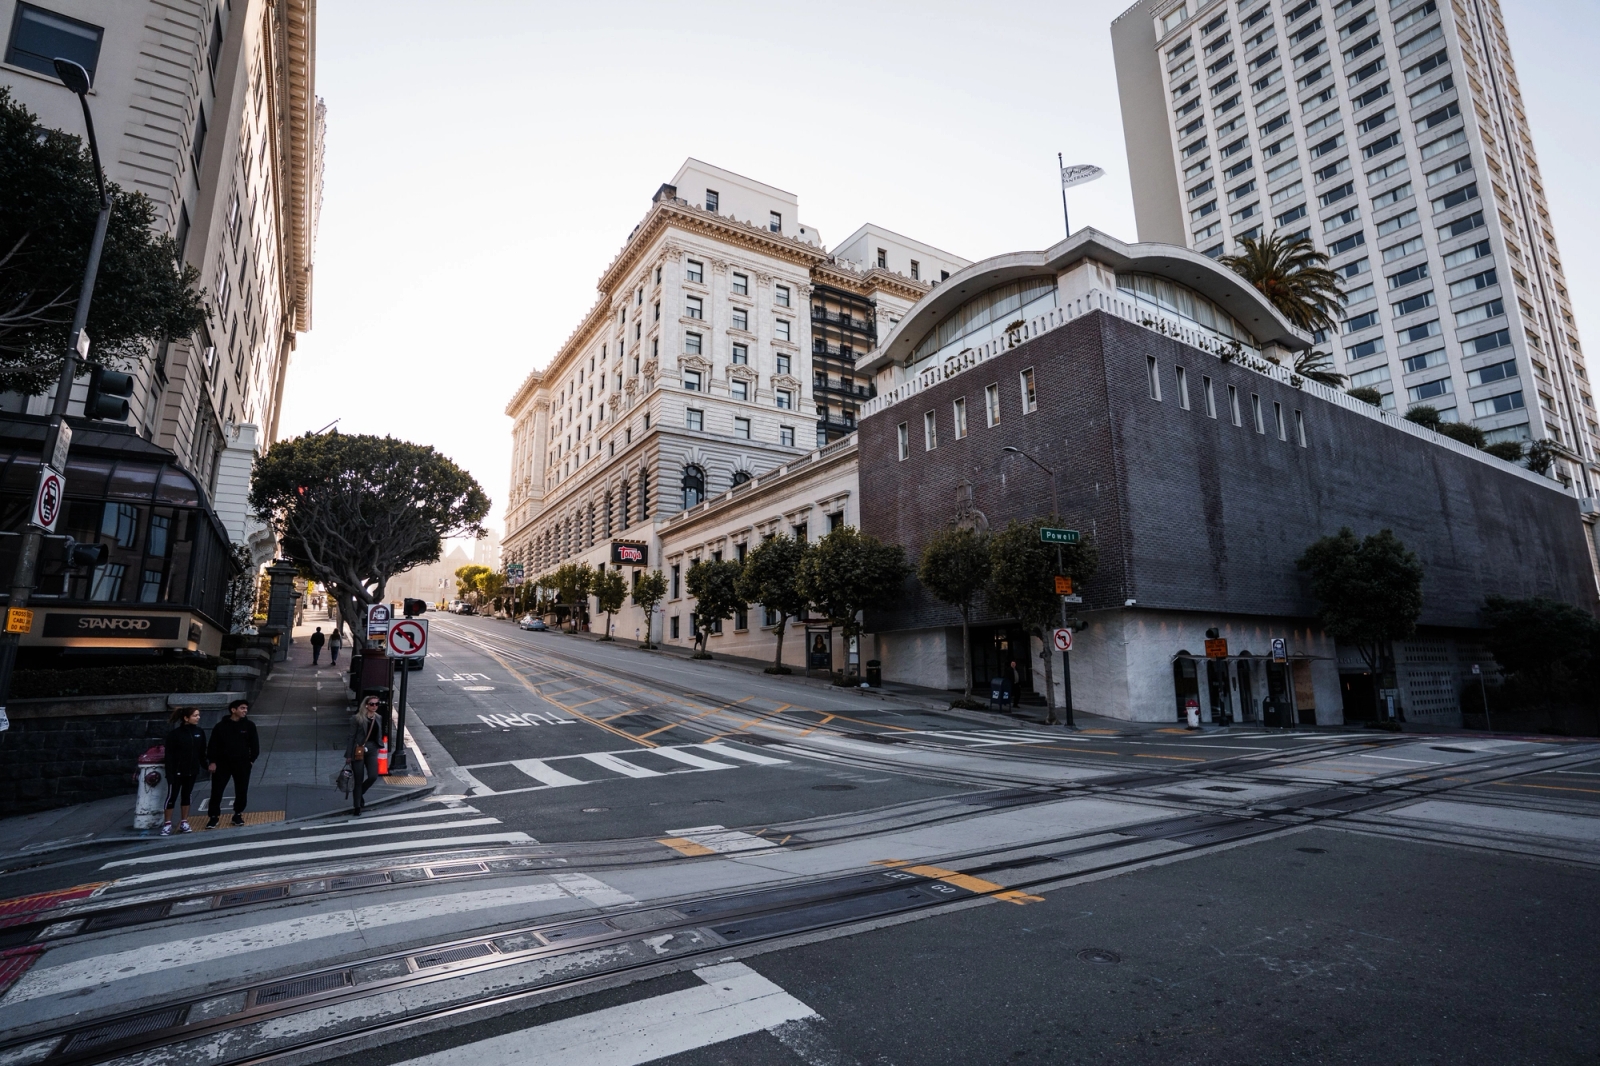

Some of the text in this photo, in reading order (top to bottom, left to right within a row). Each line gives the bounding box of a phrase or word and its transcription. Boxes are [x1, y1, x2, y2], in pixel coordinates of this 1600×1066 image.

[1046, 530, 1075, 540] Powell
[618, 546, 642, 561] Tonga
[78, 617, 151, 630] STANFORD
[436, 673, 491, 682] LEFT
[476, 711, 577, 728] TURN
[882, 871, 916, 880] LET
[931, 884, 957, 894] GO
